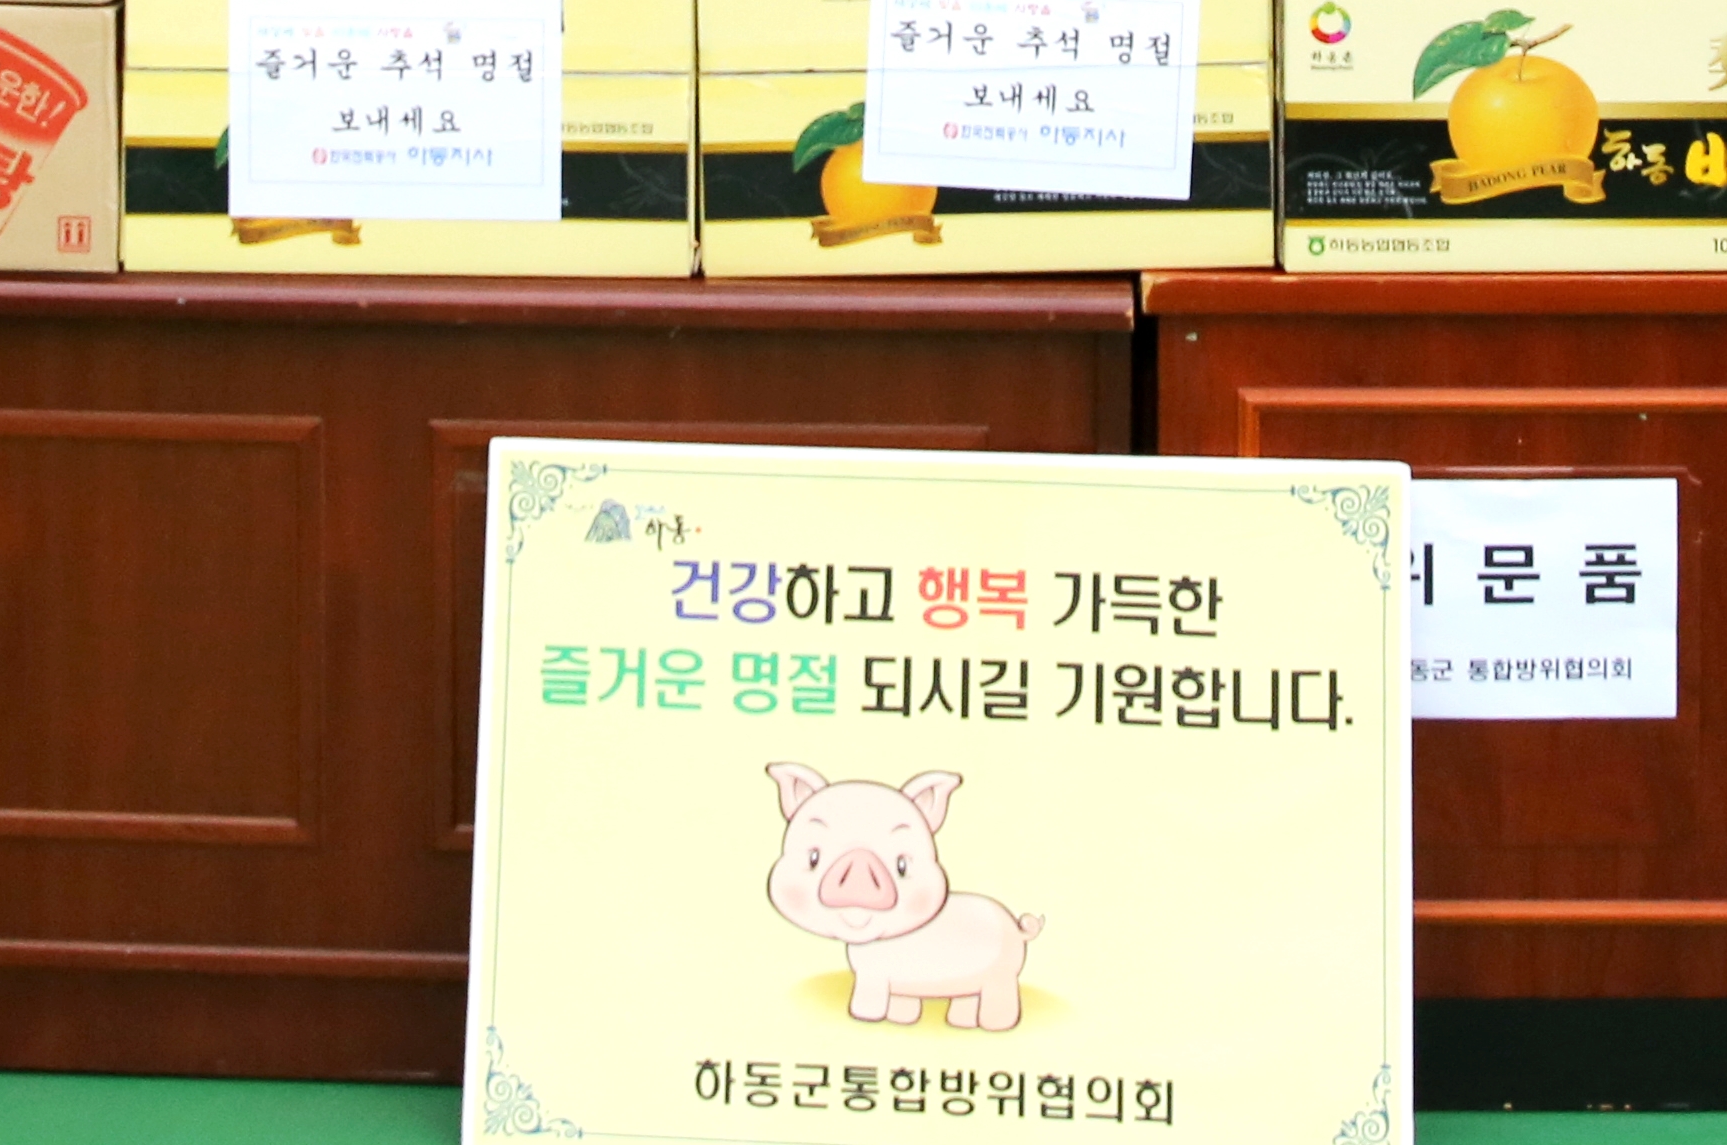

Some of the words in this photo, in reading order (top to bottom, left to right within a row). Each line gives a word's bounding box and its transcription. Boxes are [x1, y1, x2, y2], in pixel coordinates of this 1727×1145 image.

[891, 20, 994, 55] 즐거운
[1017, 25, 1081, 60] 추석
[1110, 31, 1171, 66] 명절
[256, 47, 358, 81] 즐거운
[380, 48, 445, 81] 추석
[472, 49, 534, 82] 명절
[965, 84, 1095, 114] 보내세요
[332, 106, 461, 135] 보내세요
[1468, 167, 1526, 193] HADONG
[1532, 162, 1567, 179] PEAR
[1329, 237, 1450, 253] 하동농업협동조합
[671, 560, 895, 628] 건강하고
[917, 568, 1028, 631] 행복
[1052, 570, 1223, 640] 가득한
[1411, 658, 1453, 681] 동군
[1468, 657, 1632, 681] 통합방위협의회
[539, 643, 706, 712] 즐거운
[731, 653, 838, 716] 명절
[861, 657, 1030, 722] 되시길
[1056, 661, 1354, 731] 기원합니다.
[694, 1059, 1174, 1125] 하동군통합방위협의회
